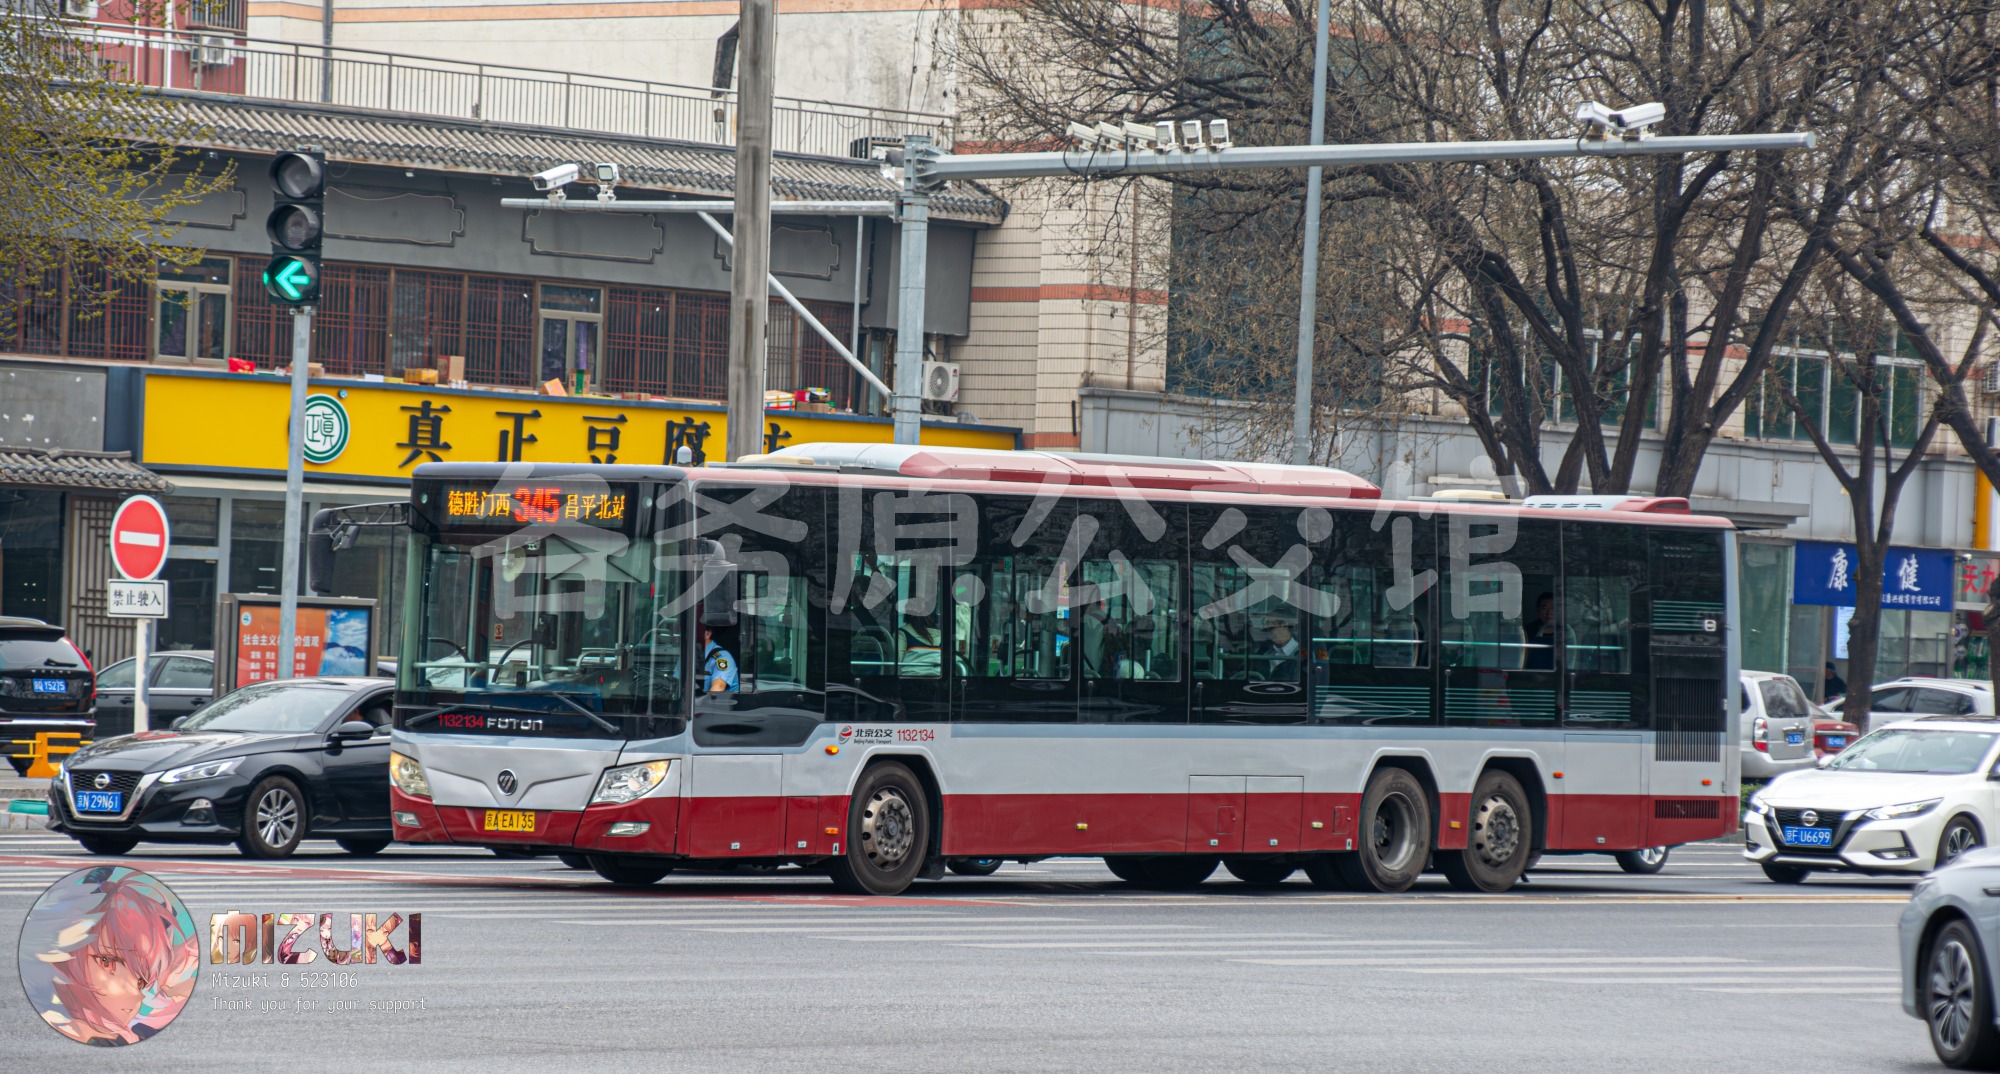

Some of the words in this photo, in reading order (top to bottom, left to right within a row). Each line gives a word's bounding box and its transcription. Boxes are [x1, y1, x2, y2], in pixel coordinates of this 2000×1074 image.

[448, 490, 511, 517] 德胜门西
[513, 488, 561, 523] 345
[564, 494, 626, 520] 昌平北站
[1829, 548, 1921, 592] 康健
[113, 589, 161, 607] 禁止驶入
[243, 634, 319, 647] 社会主义价值观
[438, 714, 484, 728] 1132134
[487, 717, 543, 731] FOTON
[854, 728, 893, 738] 北京公交
[897, 729, 935, 742] 1132134
